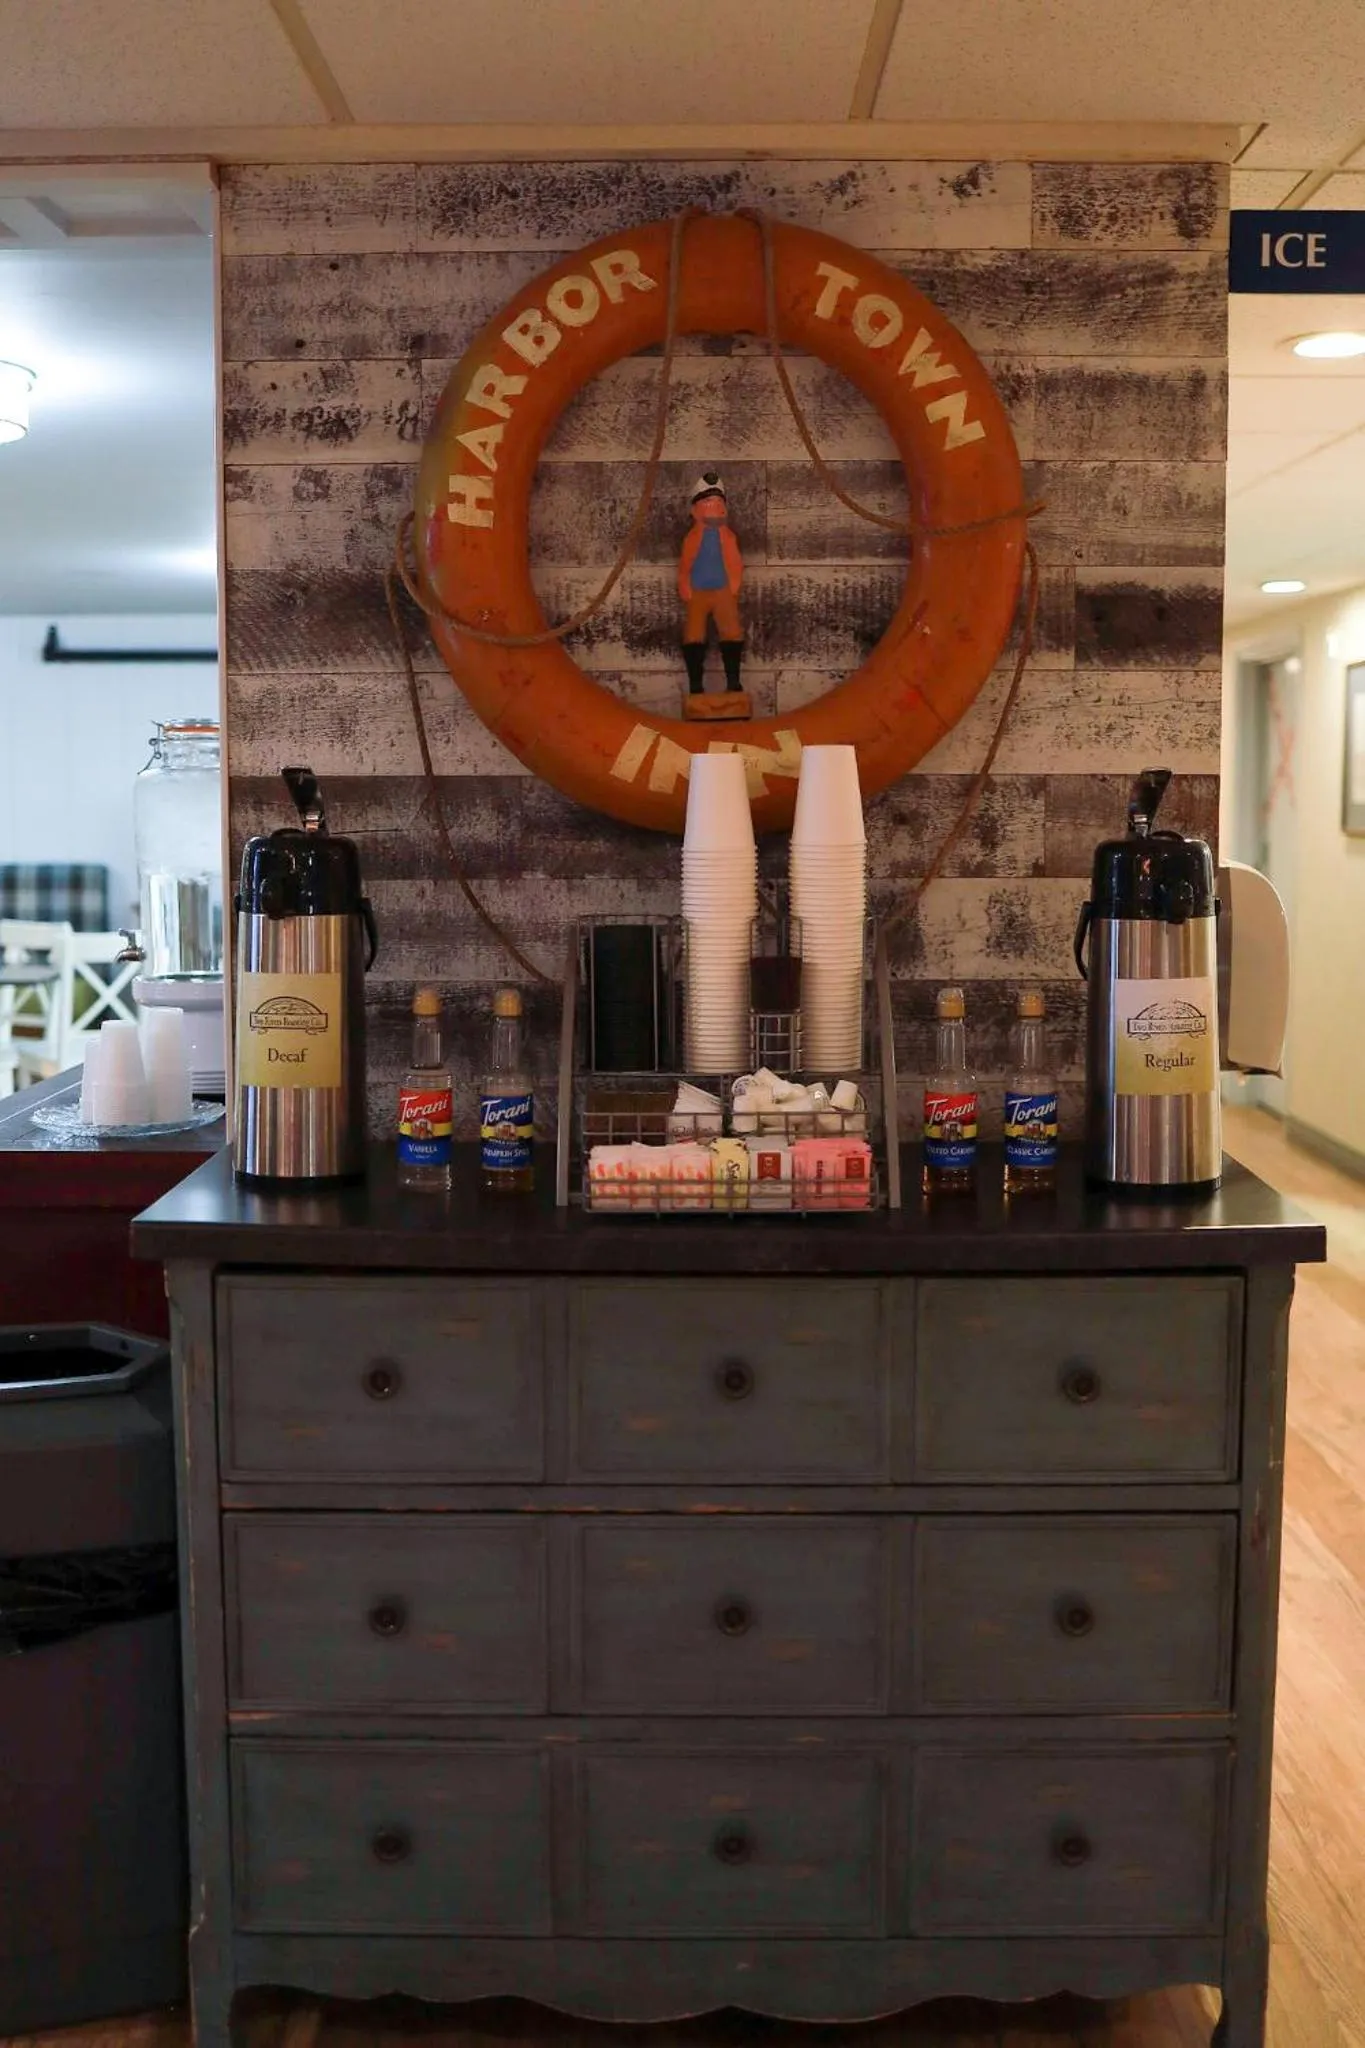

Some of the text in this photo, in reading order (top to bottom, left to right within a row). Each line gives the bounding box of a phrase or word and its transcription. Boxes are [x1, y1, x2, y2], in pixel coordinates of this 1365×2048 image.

[1261, 233, 1326, 268] ICE
[448, 250, 986, 530] HARBOR TOWN
[268, 1048, 308, 1063] Decaf
[1144, 1052, 1196, 1072] Regular
[400, 1095, 449, 1125] Torani
[481, 1097, 531, 1127] Torani
[927, 1096, 976, 1127] Torani
[1008, 1096, 1056, 1127] Torani
